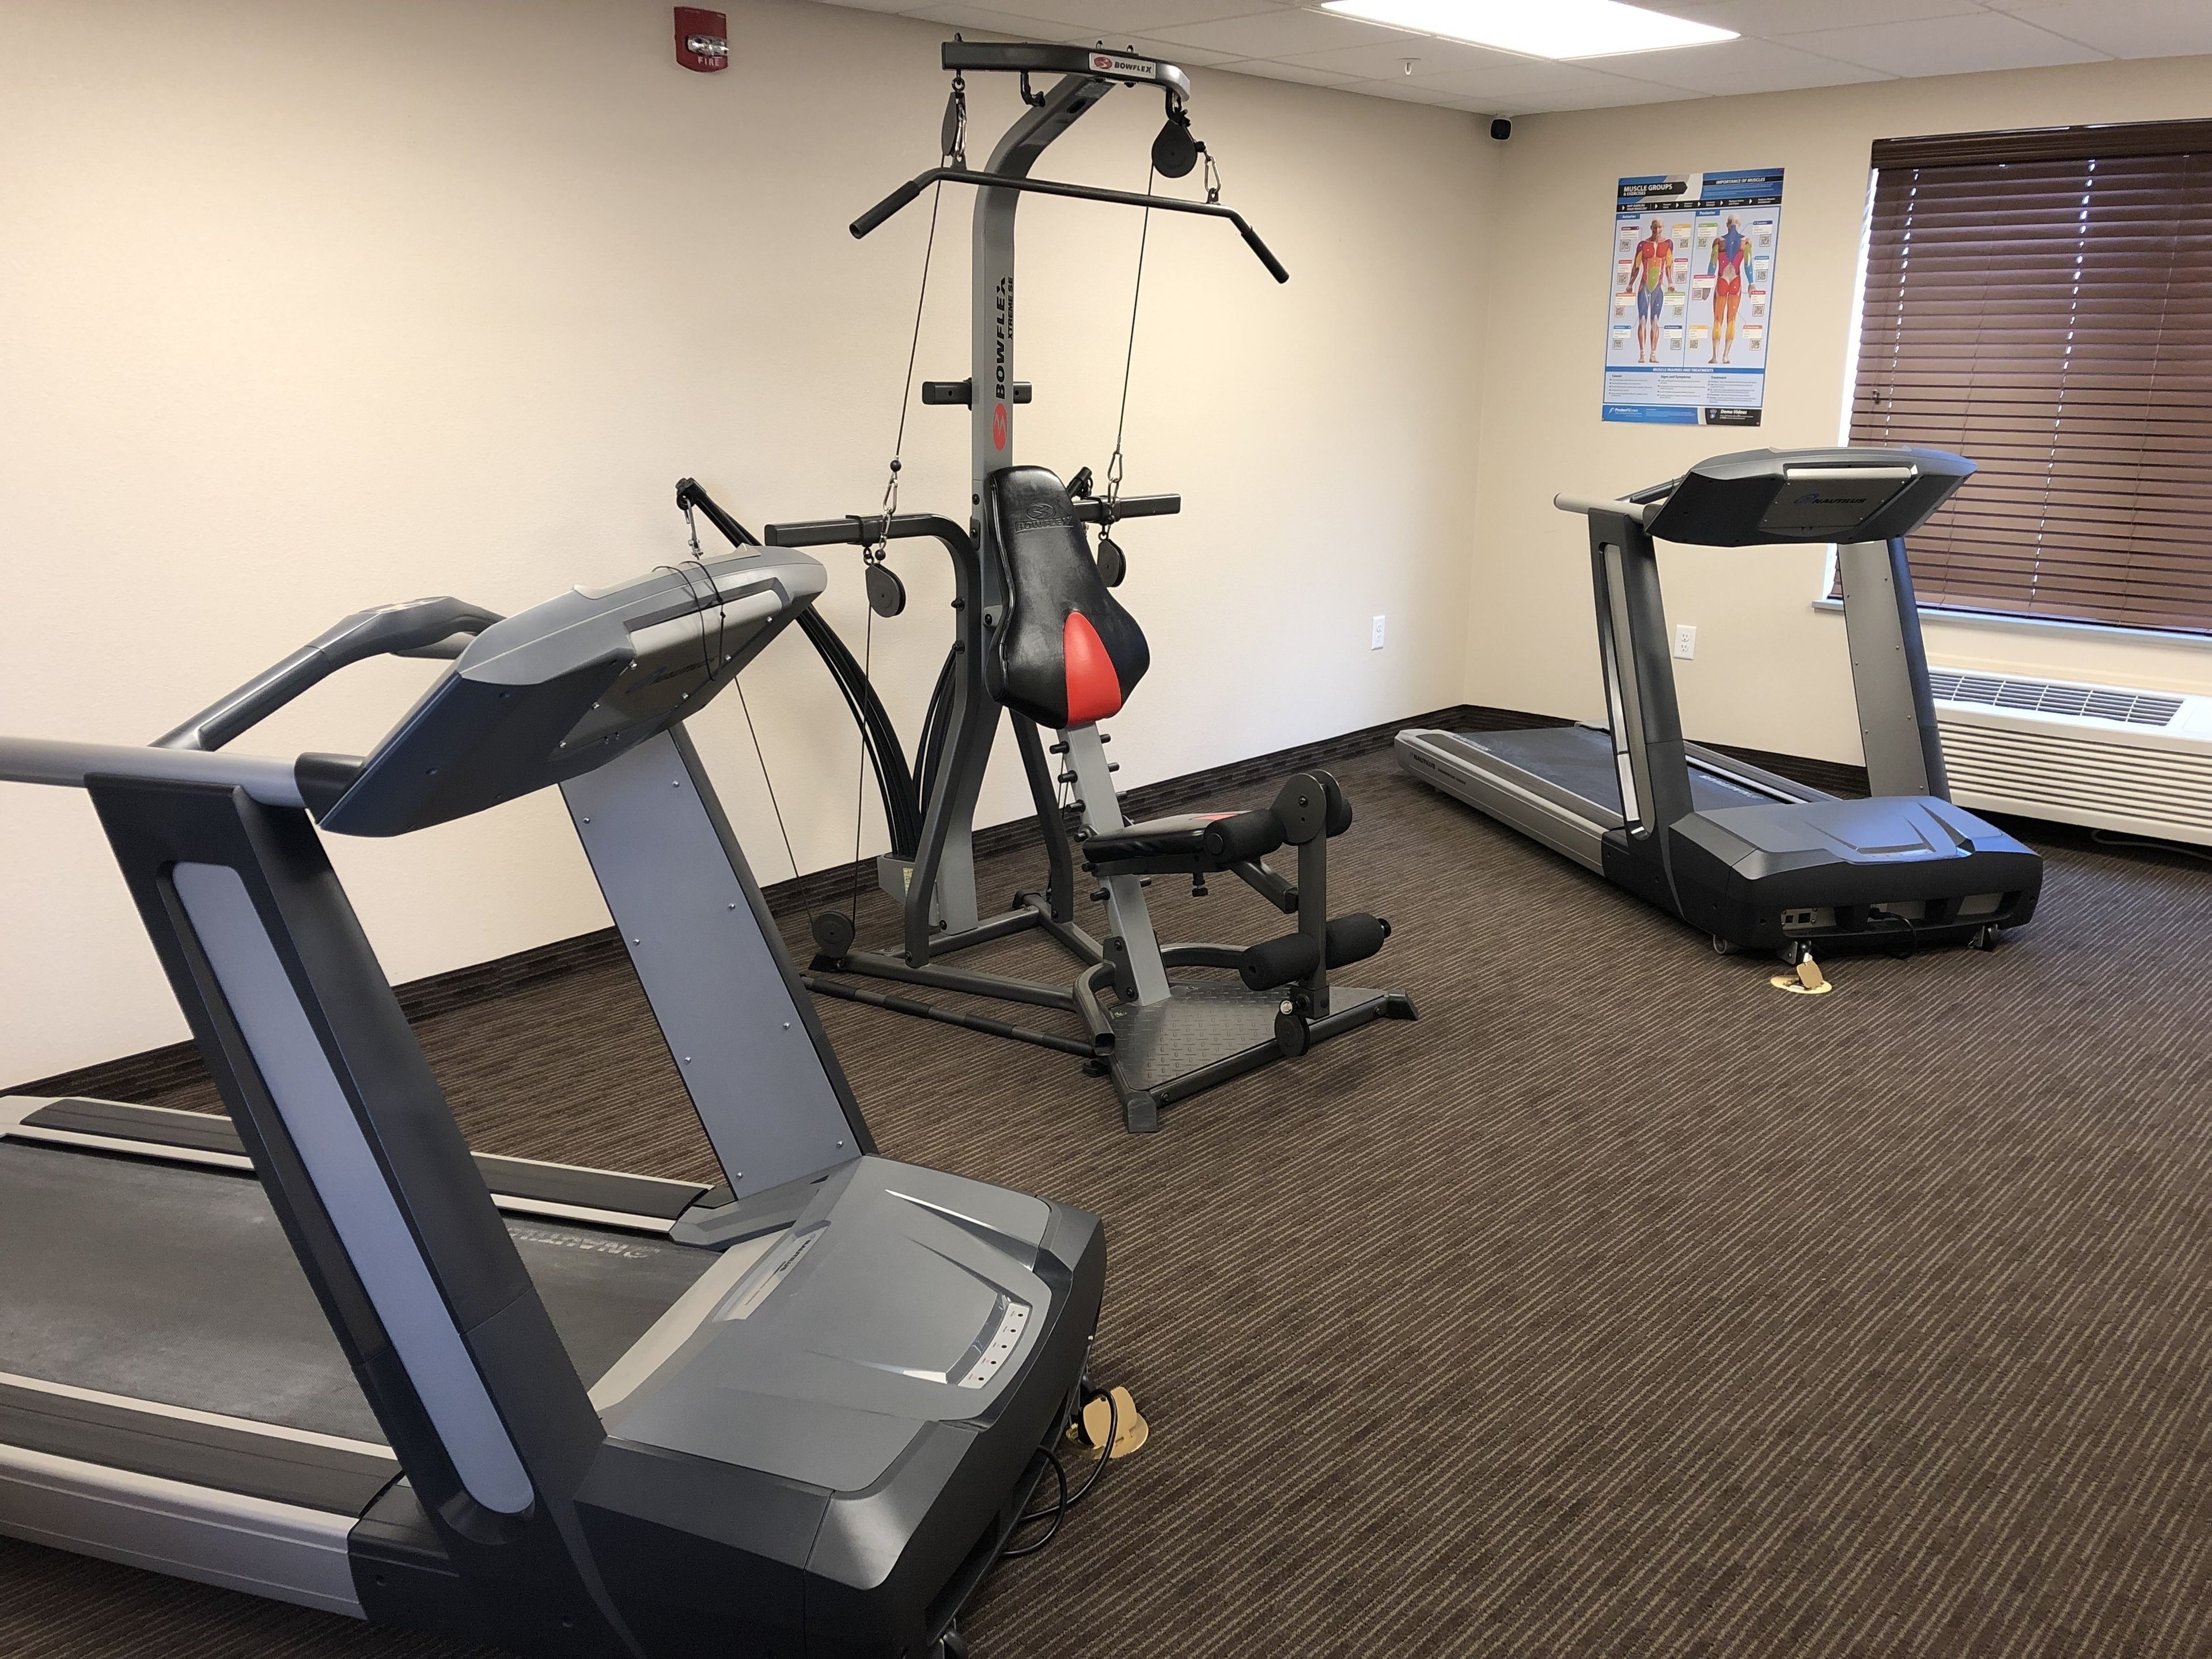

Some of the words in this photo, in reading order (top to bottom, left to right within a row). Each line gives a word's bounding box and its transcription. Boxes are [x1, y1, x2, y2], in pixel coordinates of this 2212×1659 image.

[698, 56, 719, 66] FIRE
[1114, 61, 1152, 73] BOWFLEX
[996, 276, 1005, 399] BOWFLEX
[1017, 516, 1072, 531] BOWFLEX
